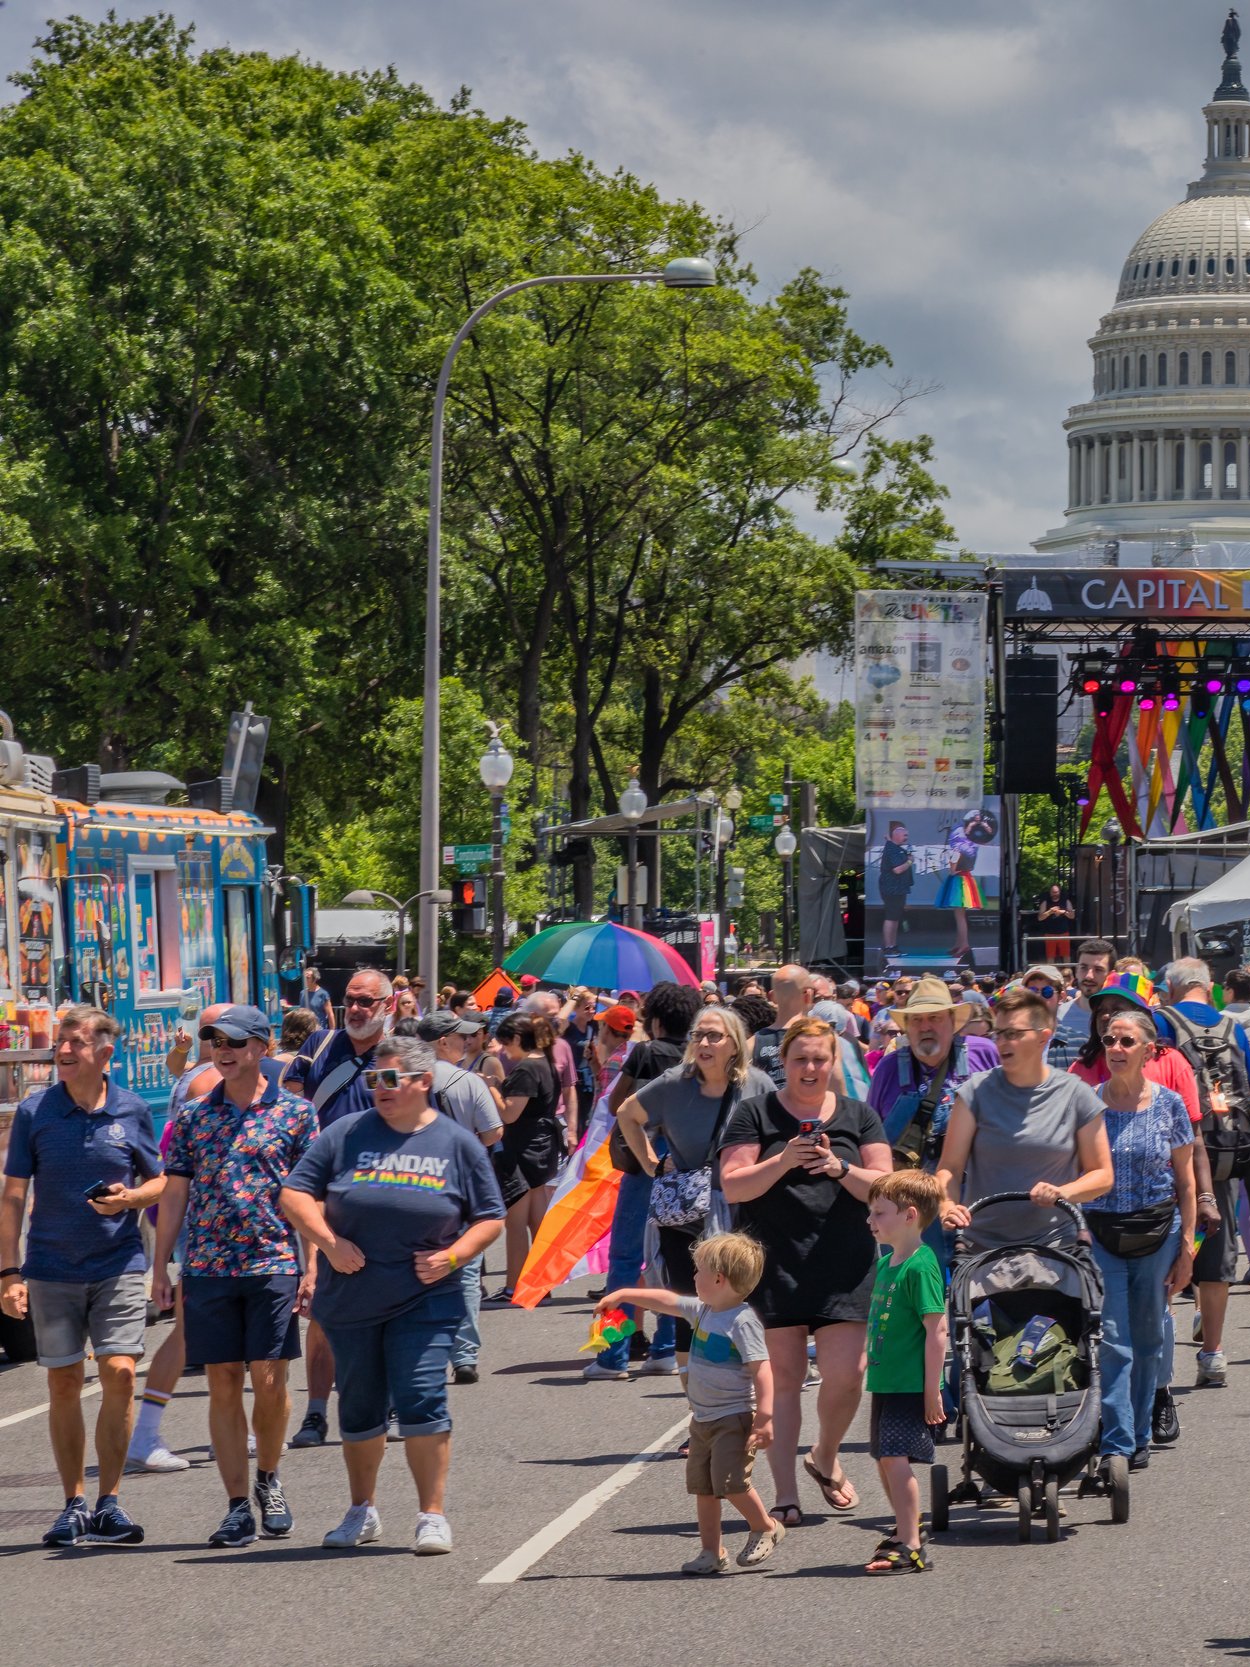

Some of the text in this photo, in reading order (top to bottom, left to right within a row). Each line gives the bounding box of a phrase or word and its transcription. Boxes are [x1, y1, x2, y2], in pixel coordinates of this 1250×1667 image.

[1081, 578, 1229, 610] CAPITAL
[859, 645, 906, 656] amazon
[356, 1151, 450, 1177] SUNDAY
